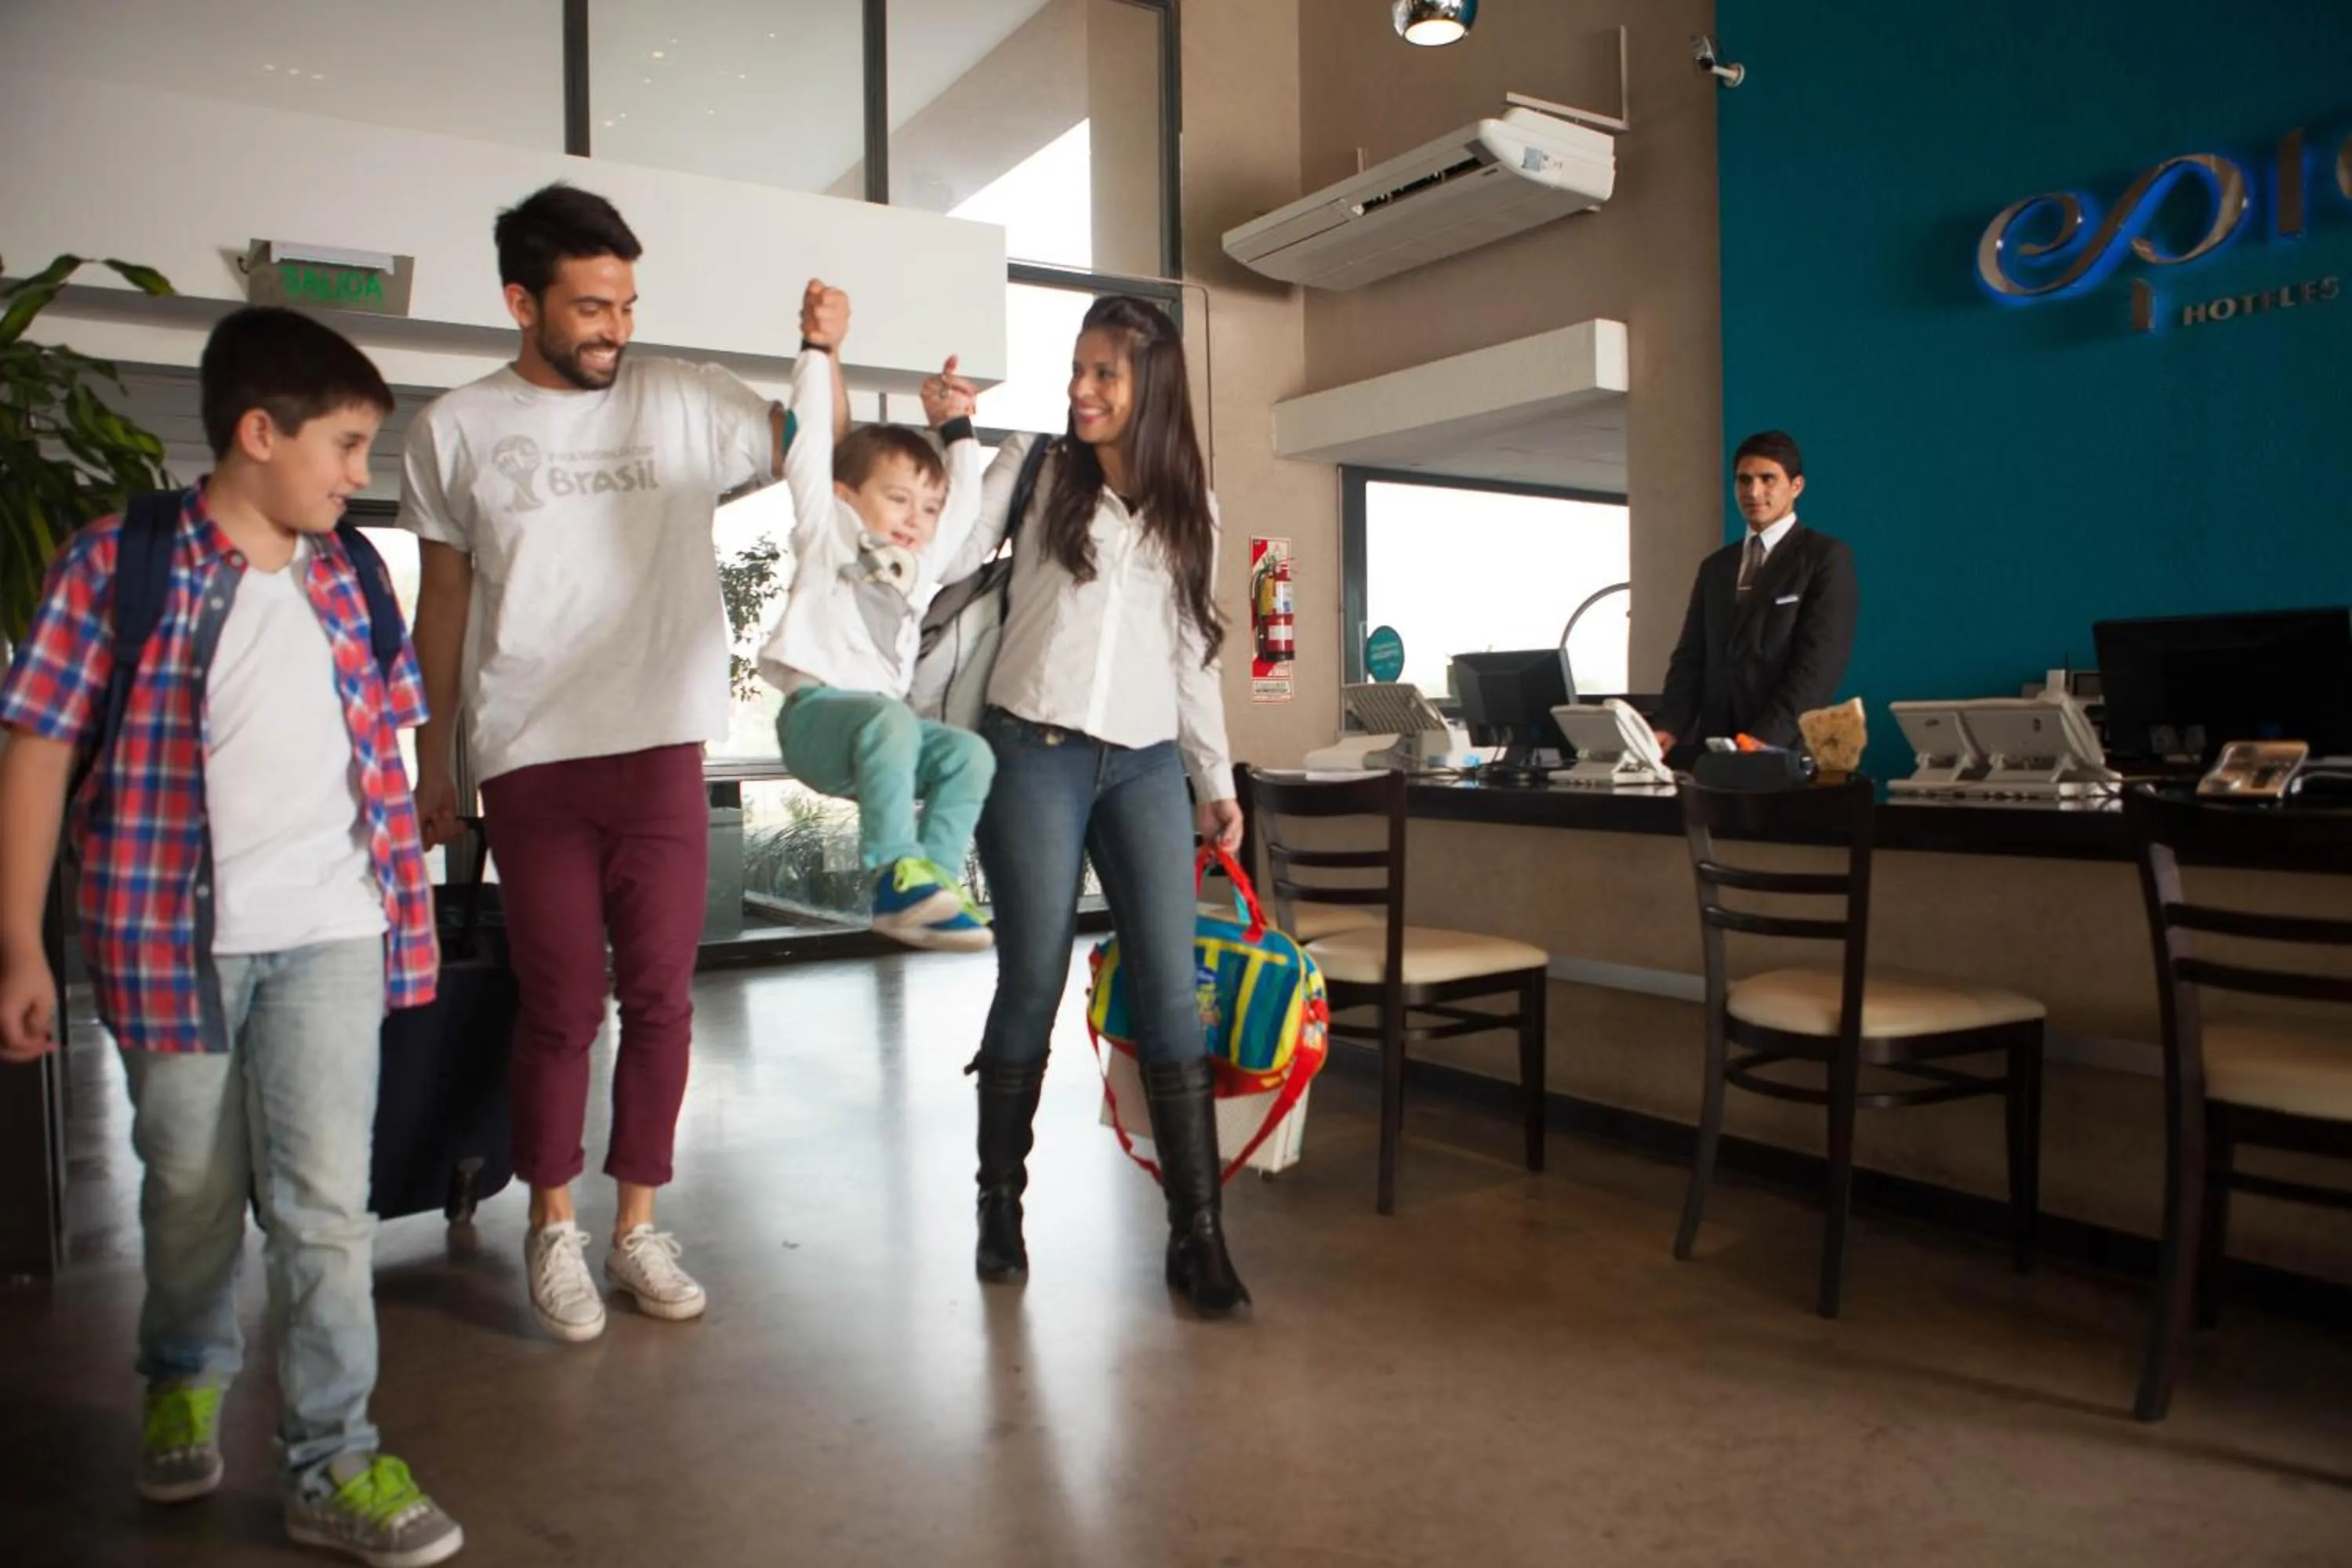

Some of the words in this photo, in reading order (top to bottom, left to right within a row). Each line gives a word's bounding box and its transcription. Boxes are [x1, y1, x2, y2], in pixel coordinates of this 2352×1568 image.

[1977, 127, 2352, 332] epi
[2183, 276, 2340, 326] HOTELES
[548, 459, 659, 496] Brasil
